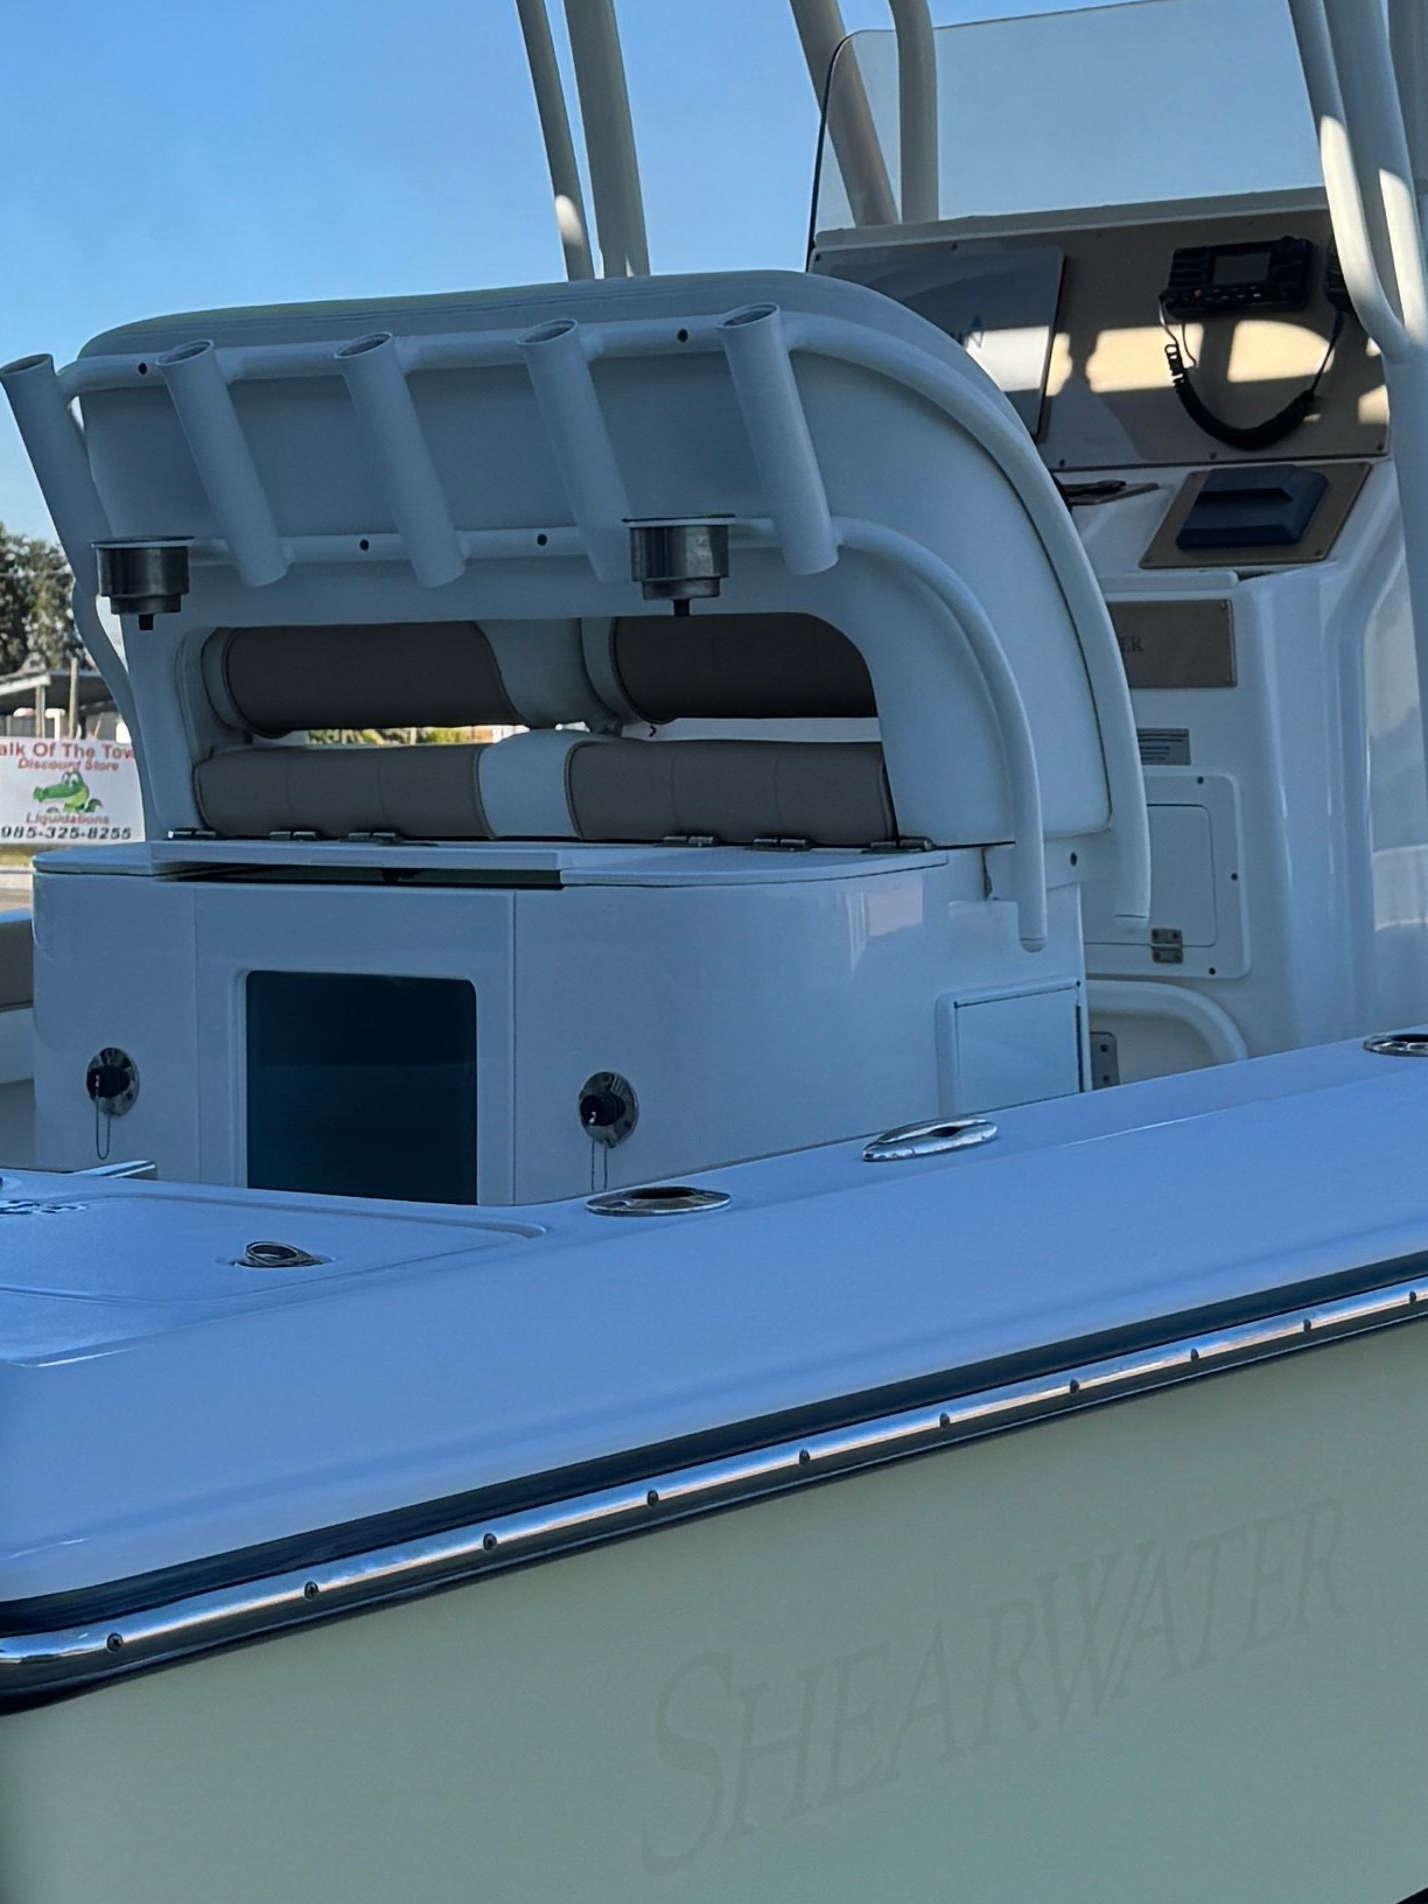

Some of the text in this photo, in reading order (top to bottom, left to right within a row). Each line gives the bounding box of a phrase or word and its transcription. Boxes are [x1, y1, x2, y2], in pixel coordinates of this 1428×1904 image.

[33, 743, 57, 758] Of
[62, 743, 96, 759] The
[102, 744, 134, 760] Tow
[18, 758, 120, 772] Discount Store
[640, 1495, 1350, 1877] SHEARWATER
